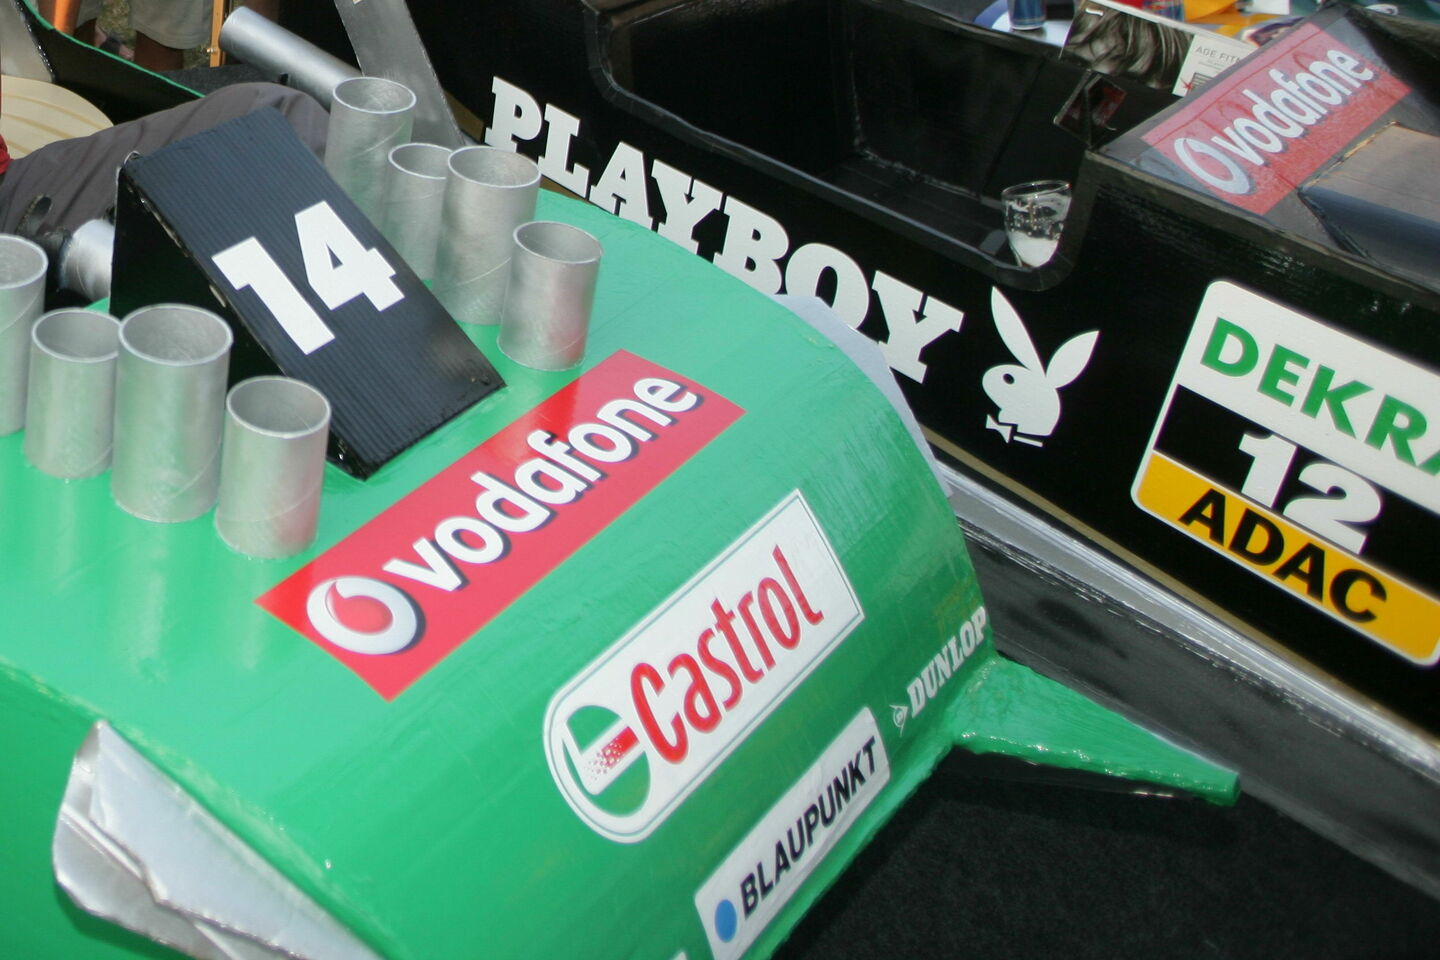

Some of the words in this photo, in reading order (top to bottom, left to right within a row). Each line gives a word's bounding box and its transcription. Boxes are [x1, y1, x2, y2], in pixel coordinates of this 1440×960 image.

[1211, 50, 1375, 166] vodafone
[212, 200, 405, 356] 14
[485, 75, 964, 384] PLAYBOY
[382, 377, 699, 593] vodafone
[1178, 488, 1387, 624] ADAC
[1238, 433, 1383, 555] 12
[630, 544, 824, 765] Castrol
[907, 606, 986, 719] DUNLOP
[740, 736, 877, 921] BLAUPUNKT
